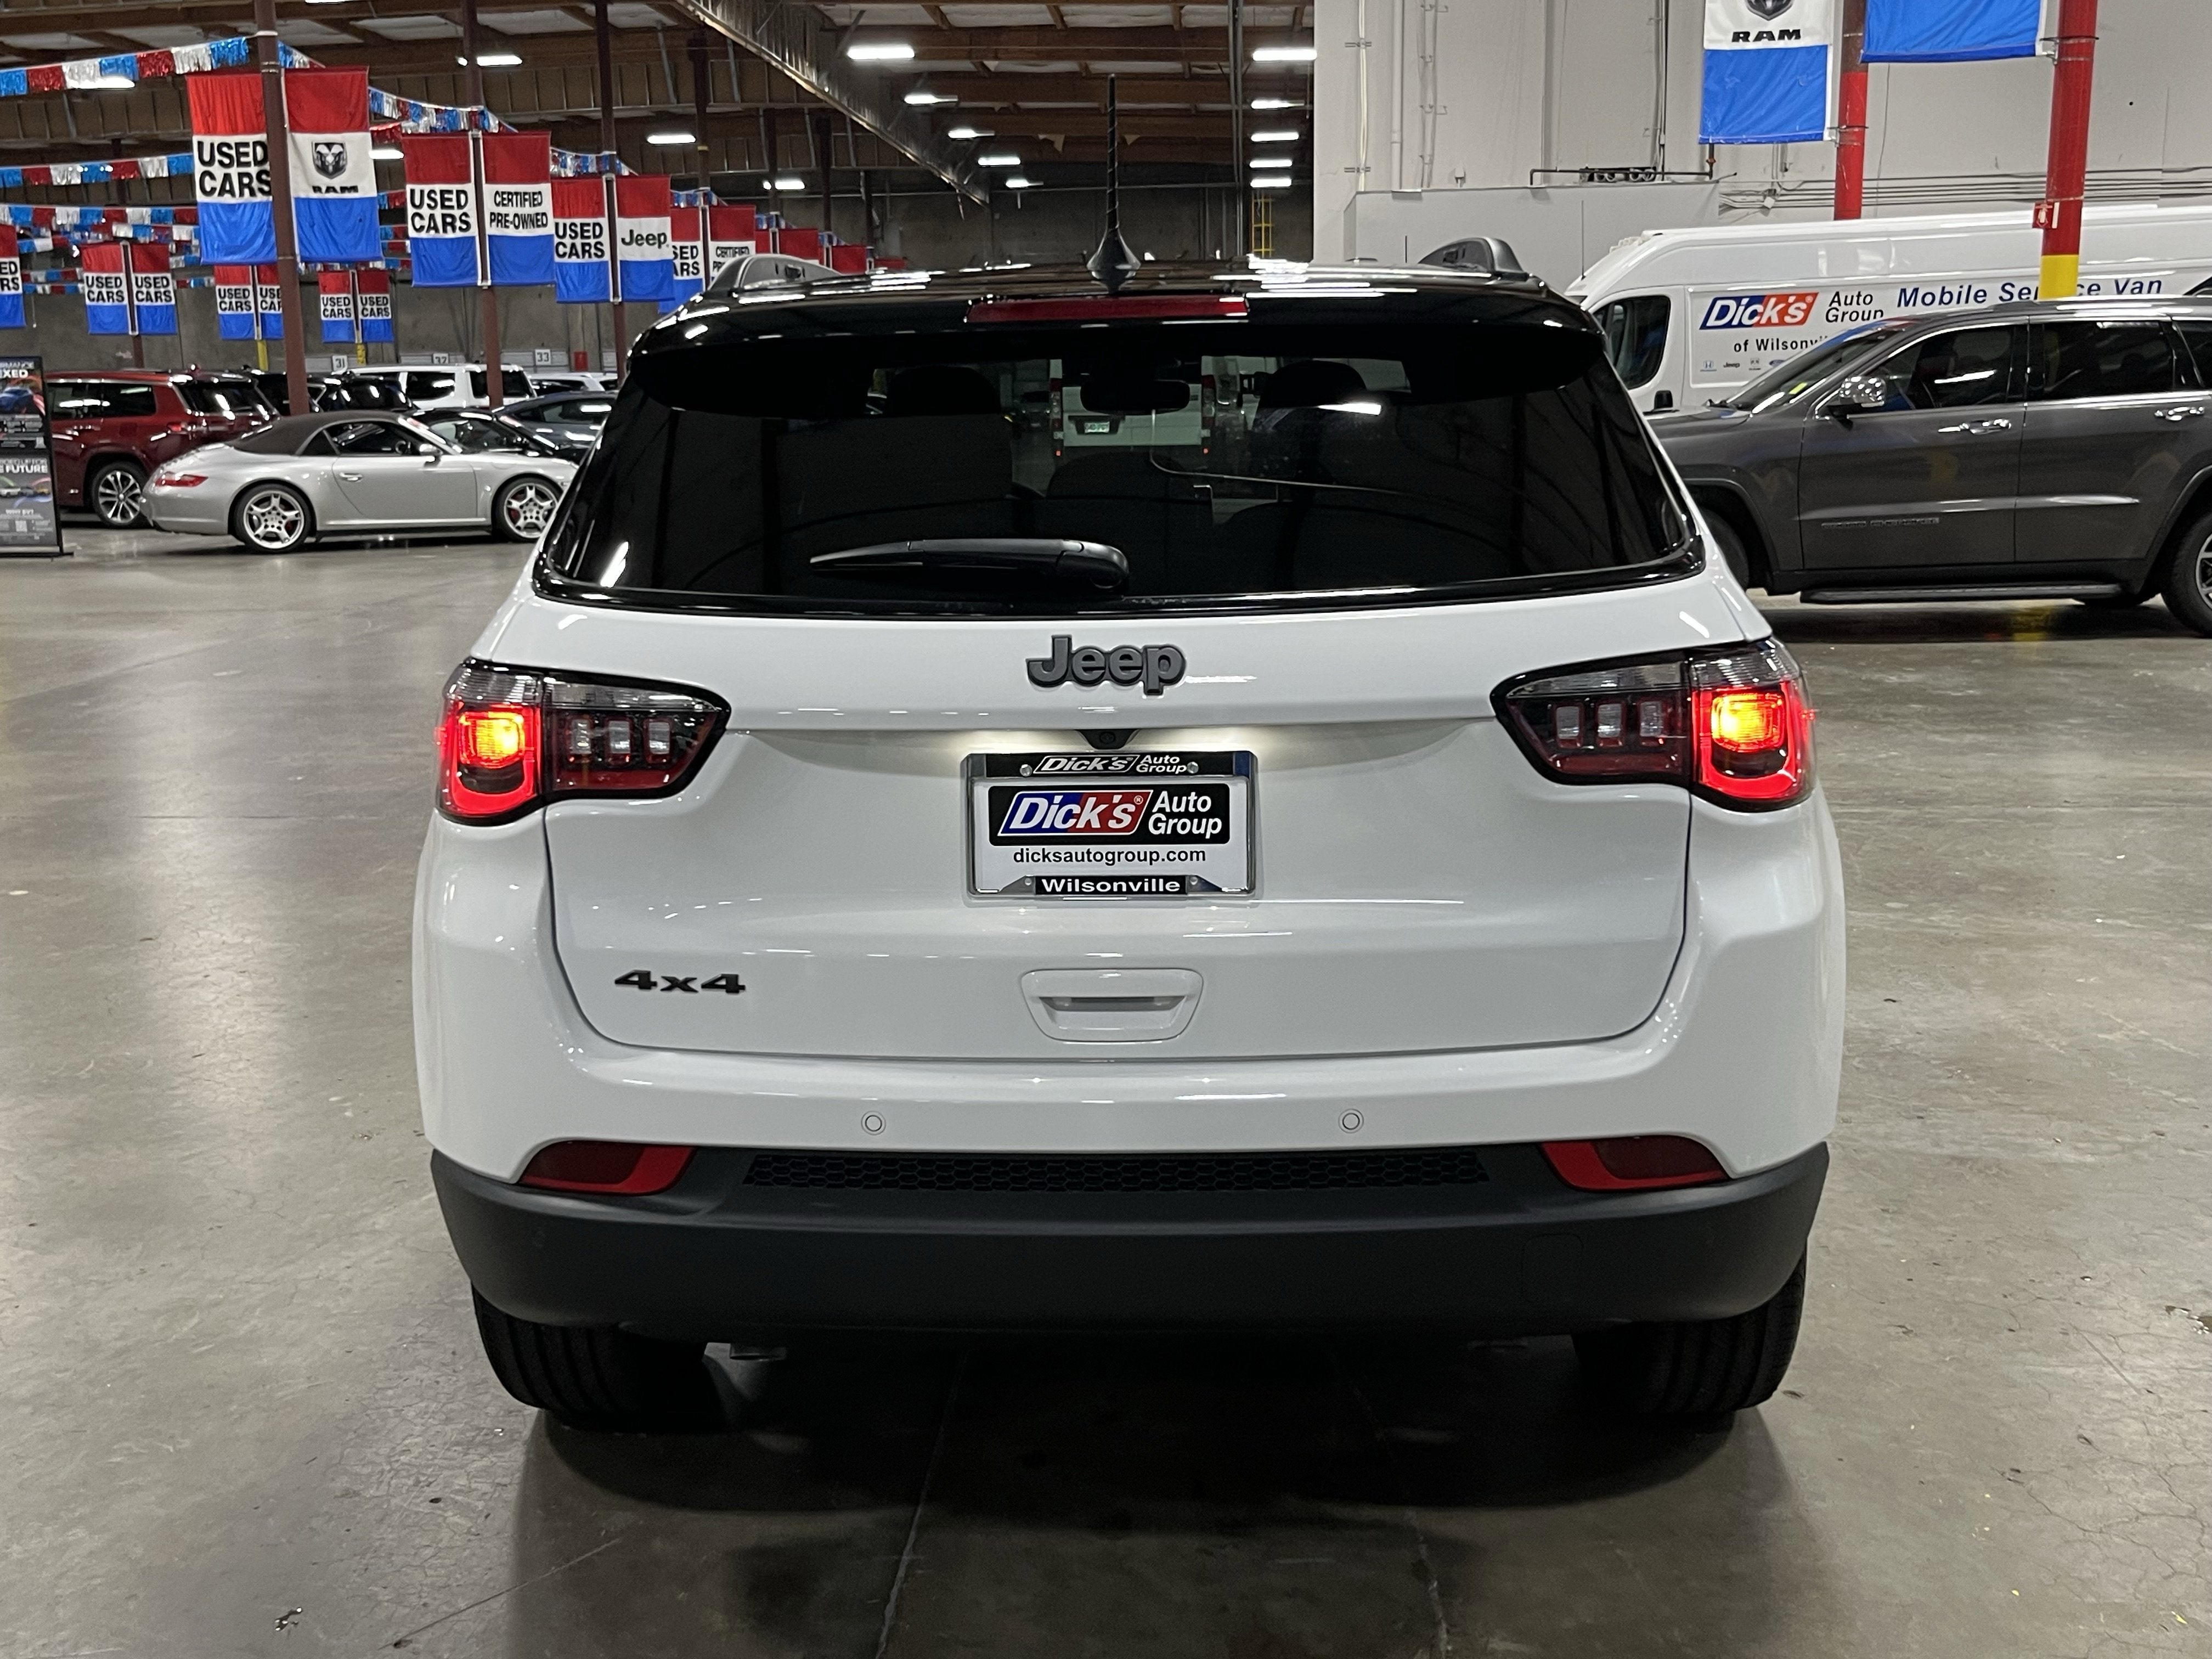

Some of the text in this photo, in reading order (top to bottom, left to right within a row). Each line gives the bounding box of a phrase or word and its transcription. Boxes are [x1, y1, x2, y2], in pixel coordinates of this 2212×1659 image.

[1731, 29, 1801, 42] RAM
[197, 140, 268, 168] USED
[199, 170, 272, 198] CARS
[410, 189, 469, 210] USED
[494, 190, 543, 207] CERTIFIED
[411, 212, 472, 234] CARS
[490, 212, 548, 229] PRE-OWNED
[555, 222, 603, 240] USED
[621, 229, 668, 249] Jeep
[555, 241, 605, 259] CARS
[672, 245, 699, 259] SED
[86, 276, 122, 289] USED
[135, 276, 170, 289] USED
[87, 291, 125, 303] CARS
[135, 291, 172, 303] CARS
[218, 287, 250, 300] USED
[1897, 285, 1987, 307] Mobile
[2114, 278, 2162, 295] Van
[219, 301, 252, 312] CARS
[322, 297, 351, 307] USED
[360, 296, 388, 306] USED
[1706, 291, 1874, 326] Dick's Auto
[323, 307, 352, 318] CARS
[361, 307, 390, 317] CARS
[1734, 340, 1749, 352] of
[335, 358, 345, 368] 31
[537, 352, 549, 362] 33
[5, 465, 48, 473] FUTURE
[1026, 635, 1186, 696] Jeep
[1041, 755, 1180, 771] Dick's Auto
[1136, 764, 1187, 774] Group
[1009, 791, 1212, 829] Dick's Auto
[1148, 813, 1222, 839] Group
[1013, 848, 1206, 866] dicksautogroup.com
[1041, 878, 1181, 893] Wilsonville
[614, 969, 746, 993] 4x4
